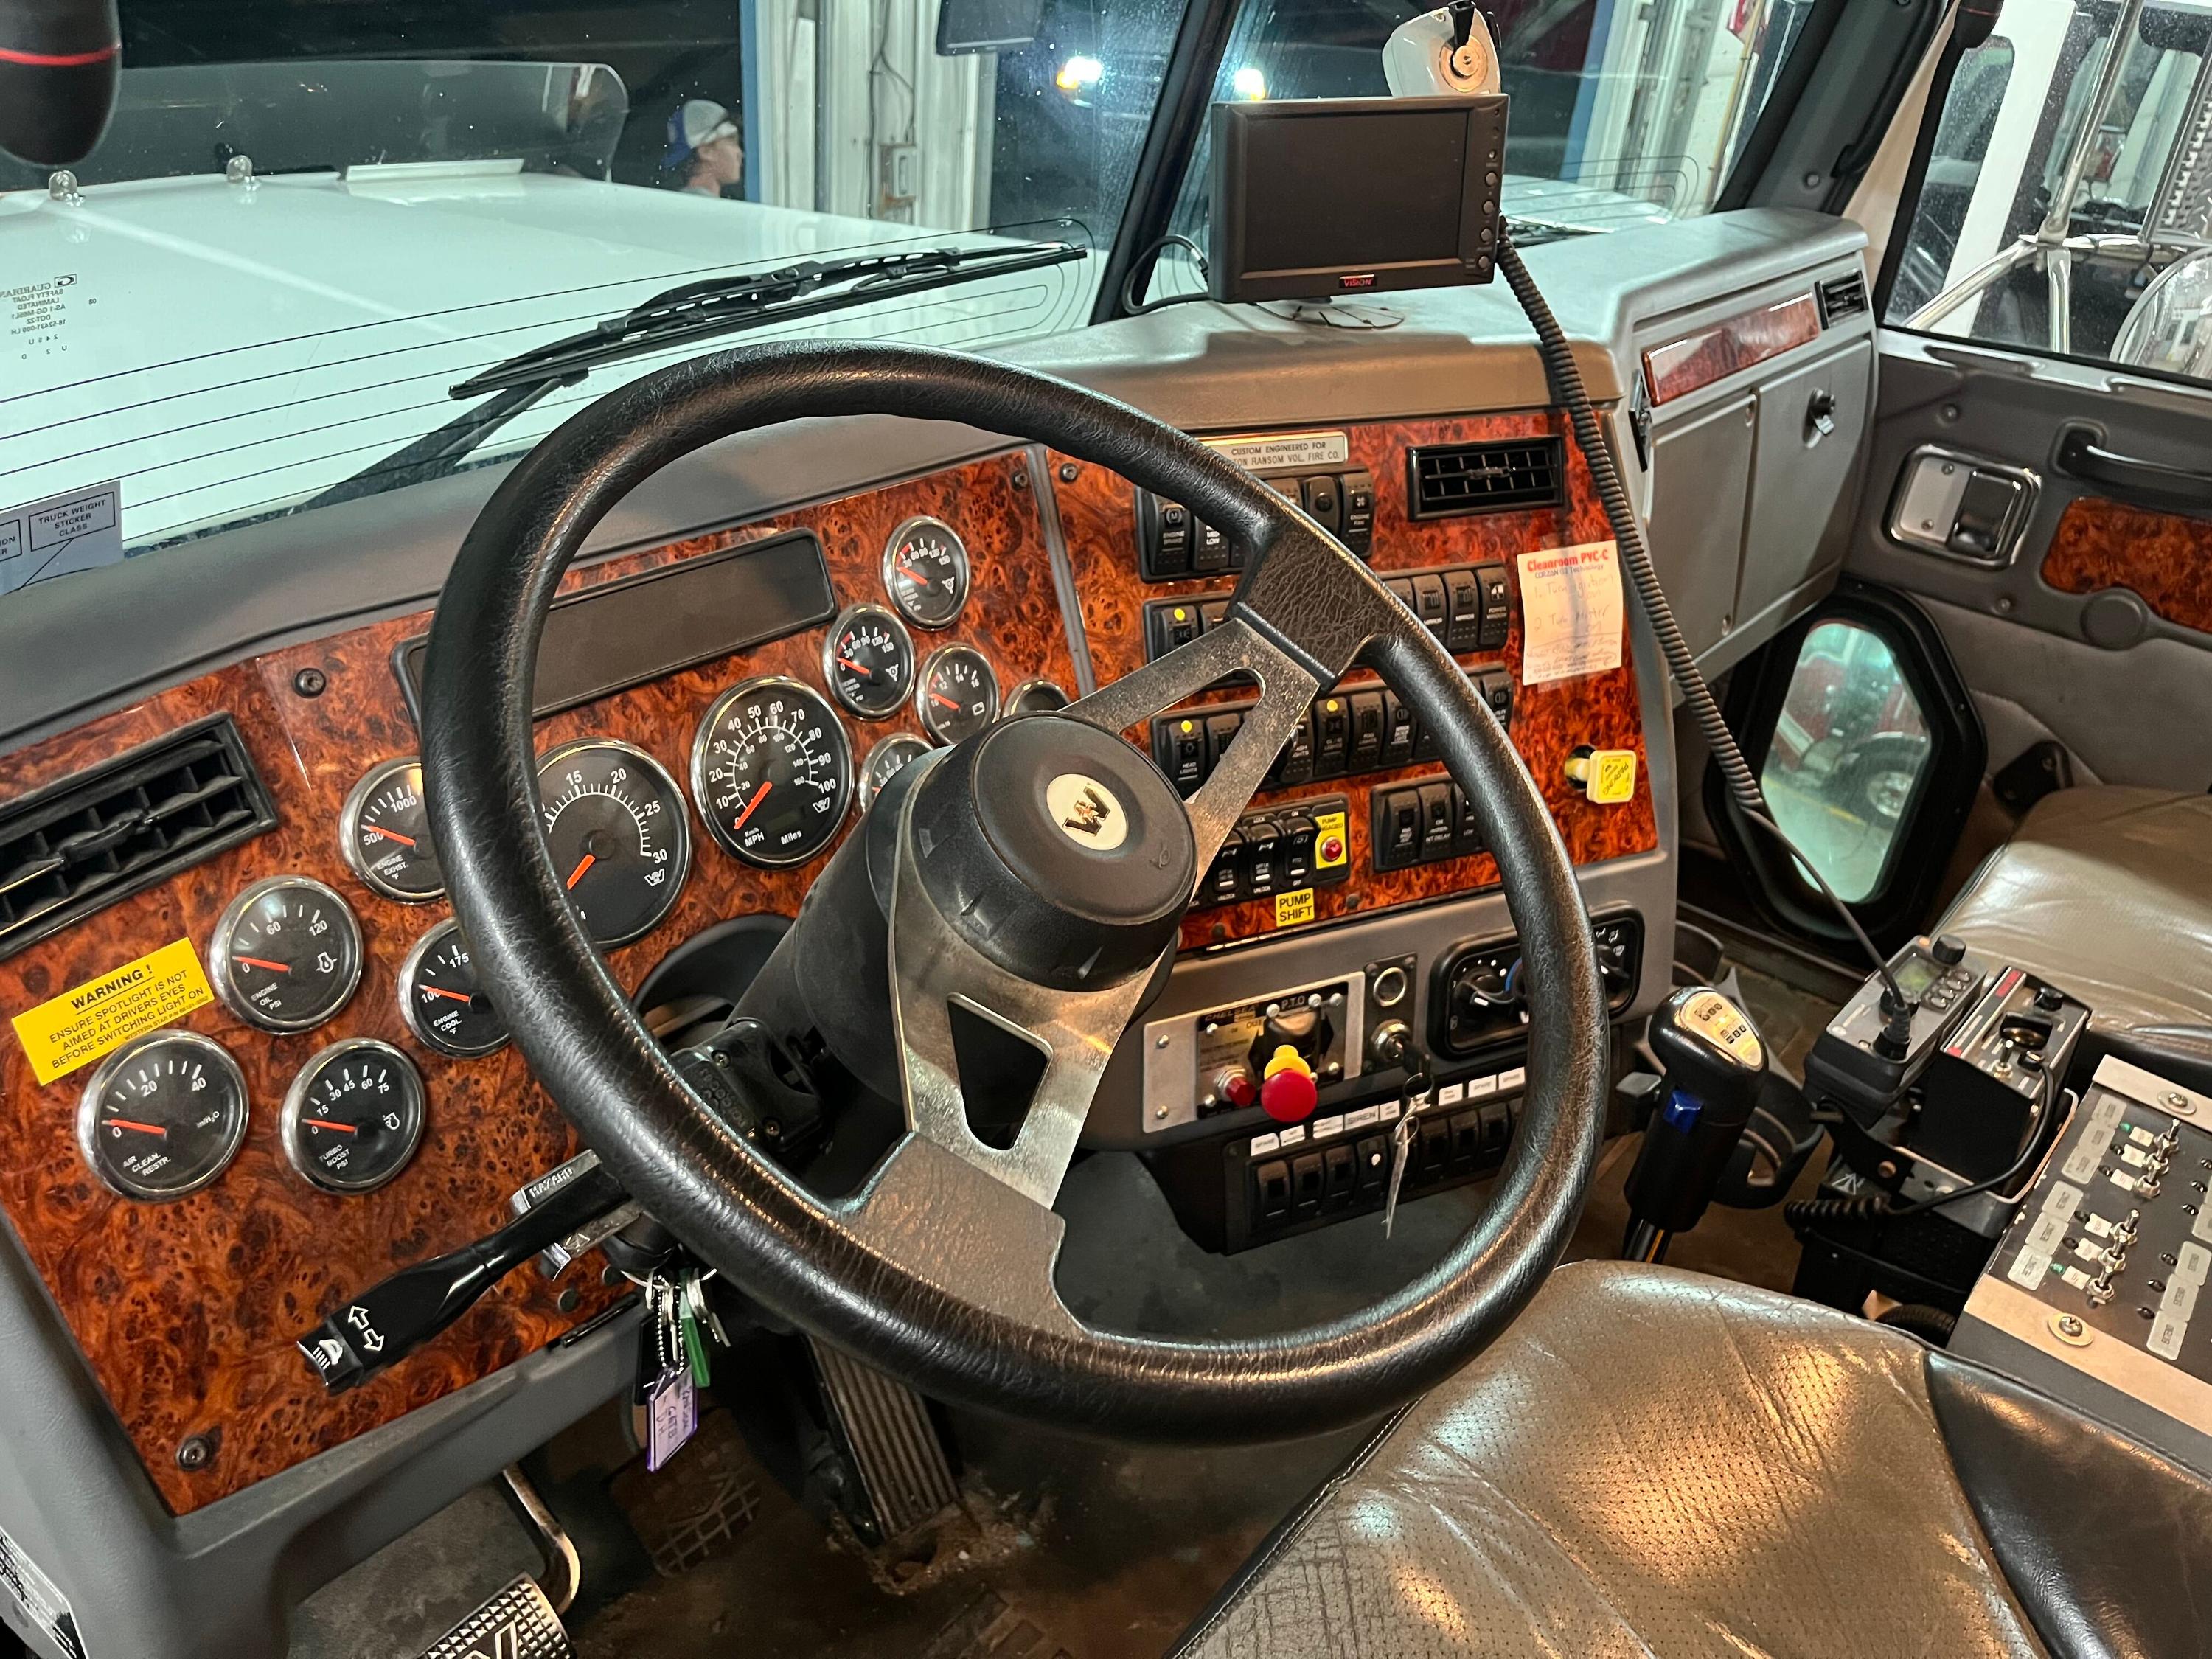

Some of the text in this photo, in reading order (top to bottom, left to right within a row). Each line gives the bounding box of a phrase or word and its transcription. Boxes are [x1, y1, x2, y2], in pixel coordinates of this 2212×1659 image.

[1231, 442, 1326, 456] CUSTOM ENGINEERED FOR
[1251, 454, 1284, 465] RANSOM
[1308, 450, 1324, 461] FIRE
[38, 499, 106, 525] TRUCK WEIGHT
[54, 512, 91, 529] STICKER
[59, 523, 88, 537] CLASS
[1528, 555, 1578, 572] Cleanroom
[709, 700, 836, 810] 10 20 30 40 50 60 70 80 90 100
[784, 744, 796, 754] 120
[739, 761, 748, 771] 40
[793, 758, 804, 768] 140
[741, 781, 751, 790] 20
[390, 796, 417, 813] 1000
[566, 768, 668, 864] 15 20 25 30
[1321, 816, 1338, 824] PUMP
[363, 832, 384, 846] 500
[744, 830, 802, 847] MPH Miles
[377, 854, 403, 870] ENGINE
[1279, 893, 1312, 909] PUMP
[1279, 905, 1313, 922] SHIFT
[266, 920, 328, 936] 60 120
[242, 963, 251, 973] 0
[449, 952, 470, 968] 175
[71, 968, 145, 1009] WARNING
[251, 982, 278, 1001] ENGINE
[49, 969, 188, 1043] ENSURE SPOTLIGHT IS NOT
[260, 996, 274, 1006] OIL
[269, 999, 282, 1010] PSI
[63, 984, 186, 1051] AIMED AT DRIVERS EYES
[433, 1010, 459, 1026] ENGINE
[51, 986, 204, 1069] BEFORE SWITCHING LIGHT ON
[124, 1024, 153, 1041] WESTERN
[153, 1016, 169, 1027] STAR
[140, 1077, 207, 1097] 20 40
[311, 1077, 390, 1135] 0 15 30 45 60 75
[1347, 1112, 1377, 1126] SIREN
[112, 1126, 122, 1138] 0
[319, 1144, 343, 1163] TURBO
[327, 1148, 350, 1168] BOOST
[123, 1155, 138, 1169] AIR
[131, 1152, 161, 1173] CLEAN.
[142, 1155, 171, 1177] RESTR.
[336, 1158, 349, 1170] PSI
[529, 1166, 573, 1199] HAZARD
